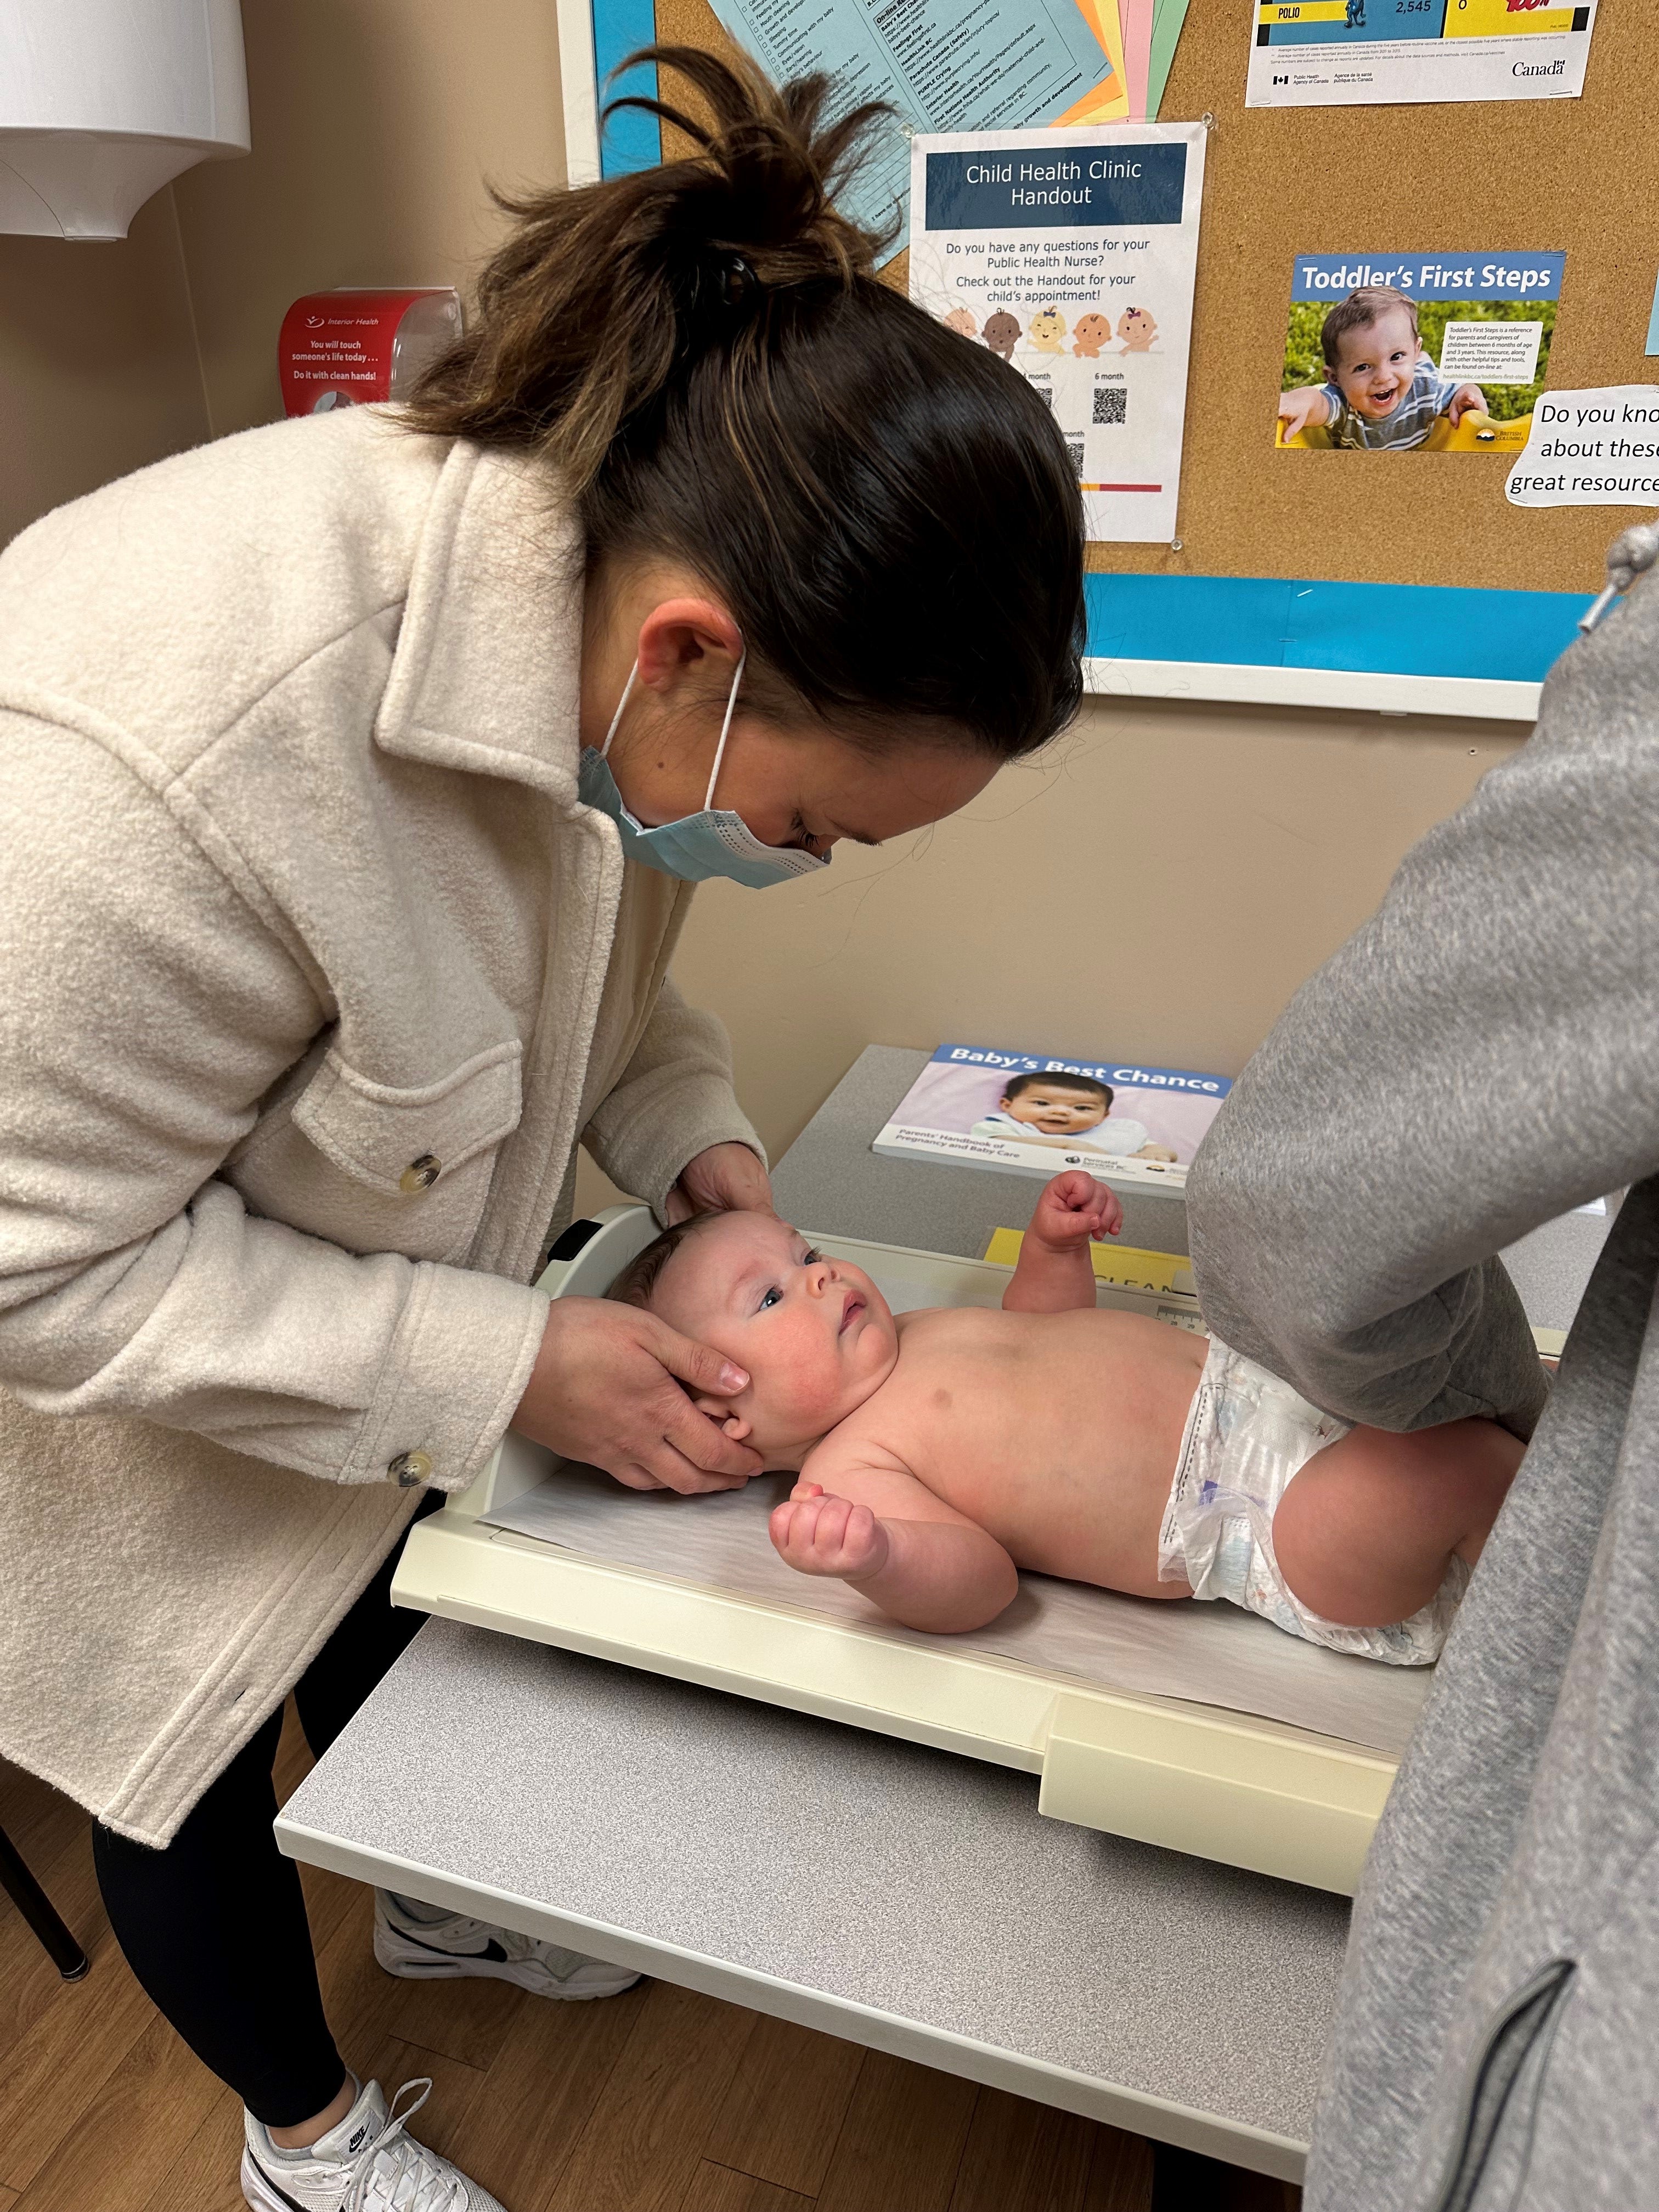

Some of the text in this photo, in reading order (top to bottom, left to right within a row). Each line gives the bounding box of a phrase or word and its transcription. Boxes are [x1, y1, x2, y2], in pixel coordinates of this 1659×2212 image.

[760, 15, 773, 27] Mouth
[773, 0, 790, 16] cleaning
[877, 5, 898, 24] On-line
[1278, 7, 1300, 19] POLIO
[1396, 1, 1431, 14] 2,545
[765, 13, 788, 35] Growth and
[881, 7, 907, 32] Baby's Best
[769, 26, 787, 43] Sleeping
[772, 28, 798, 50] Tummy time
[777, 7, 834, 58] Communicating with my baby
[893, 24, 923, 52] Feelings First
[925, 37, 932, 46] BC
[909, 28, 969, 81] Parachute Canada (Safety)
[1512, 60, 1564, 76] Canada
[918, 66, 951, 96] PURPLE Crying
[926, 81, 960, 110] Interior Health
[934, 67, 1000, 125] First Nations Health Authority
[1024, 72, 1082, 123] growth and development
[967, 160, 1141, 183] Child Health Clinic
[1012, 187, 1092, 205] Handout
[947, 239, 1150, 256] Do you have any questions for your
[988, 256, 1104, 268] Public Health Nurse?
[957, 274, 1136, 287] Check out the Handout for your
[1302, 264, 1551, 292] Toddler's First Steps
[987, 290, 1101, 302] child's appointment!
[311, 340, 324, 348] You
[332, 352, 344, 361] life
[313, 371, 329, 379] with
[330, 371, 349, 380] clean
[351, 372, 376, 380] hands!
[1541, 405, 1569, 422] Do
[1577, 409, 1615, 427] you
[1541, 438, 1603, 456] about
[1510, 475, 1566, 494] great
[950, 1048, 1220, 1092] Baby's Best Chance
[896, 1135, 947, 1147] Pregnancy
[969, 1146, 995, 1154] Baby
[997, 1149, 1019, 1158] Care
[940, 1135, 990, 1147] Handbook
[350, 2125, 365, 2146] NIKE
